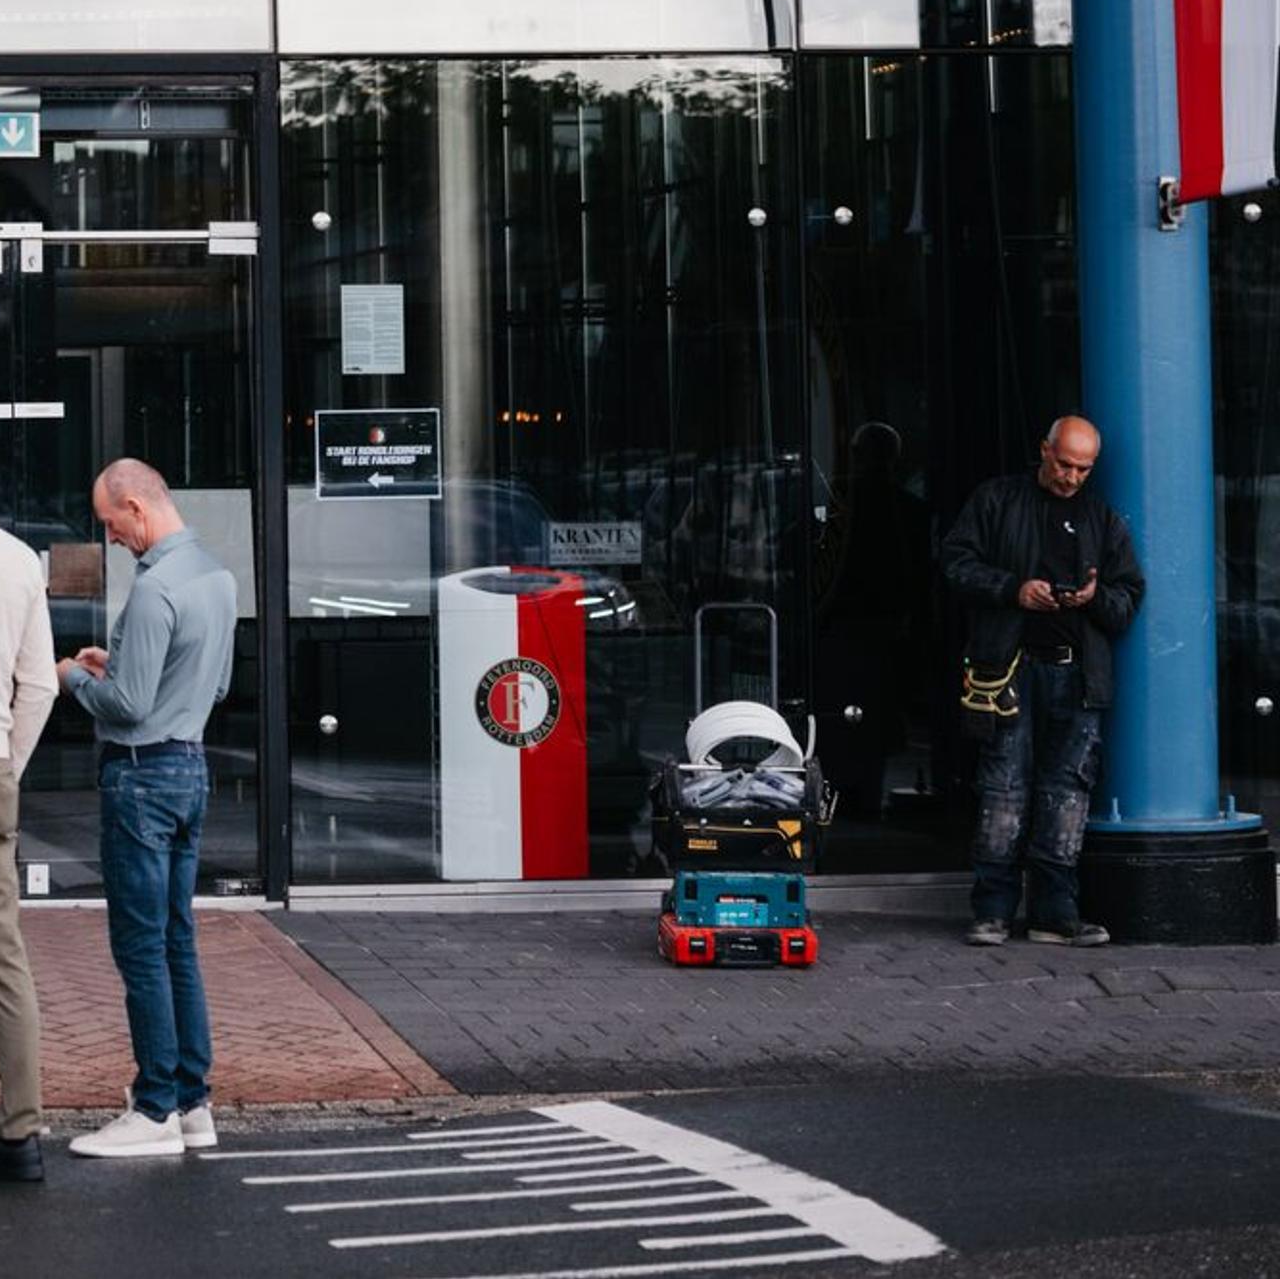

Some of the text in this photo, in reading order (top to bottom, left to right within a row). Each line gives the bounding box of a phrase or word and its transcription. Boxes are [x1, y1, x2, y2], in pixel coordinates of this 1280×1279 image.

[326, 446, 357, 456] START
[481, 660, 555, 690] FEYENOORD
[481, 714, 555, 746] ROTTERDAM
